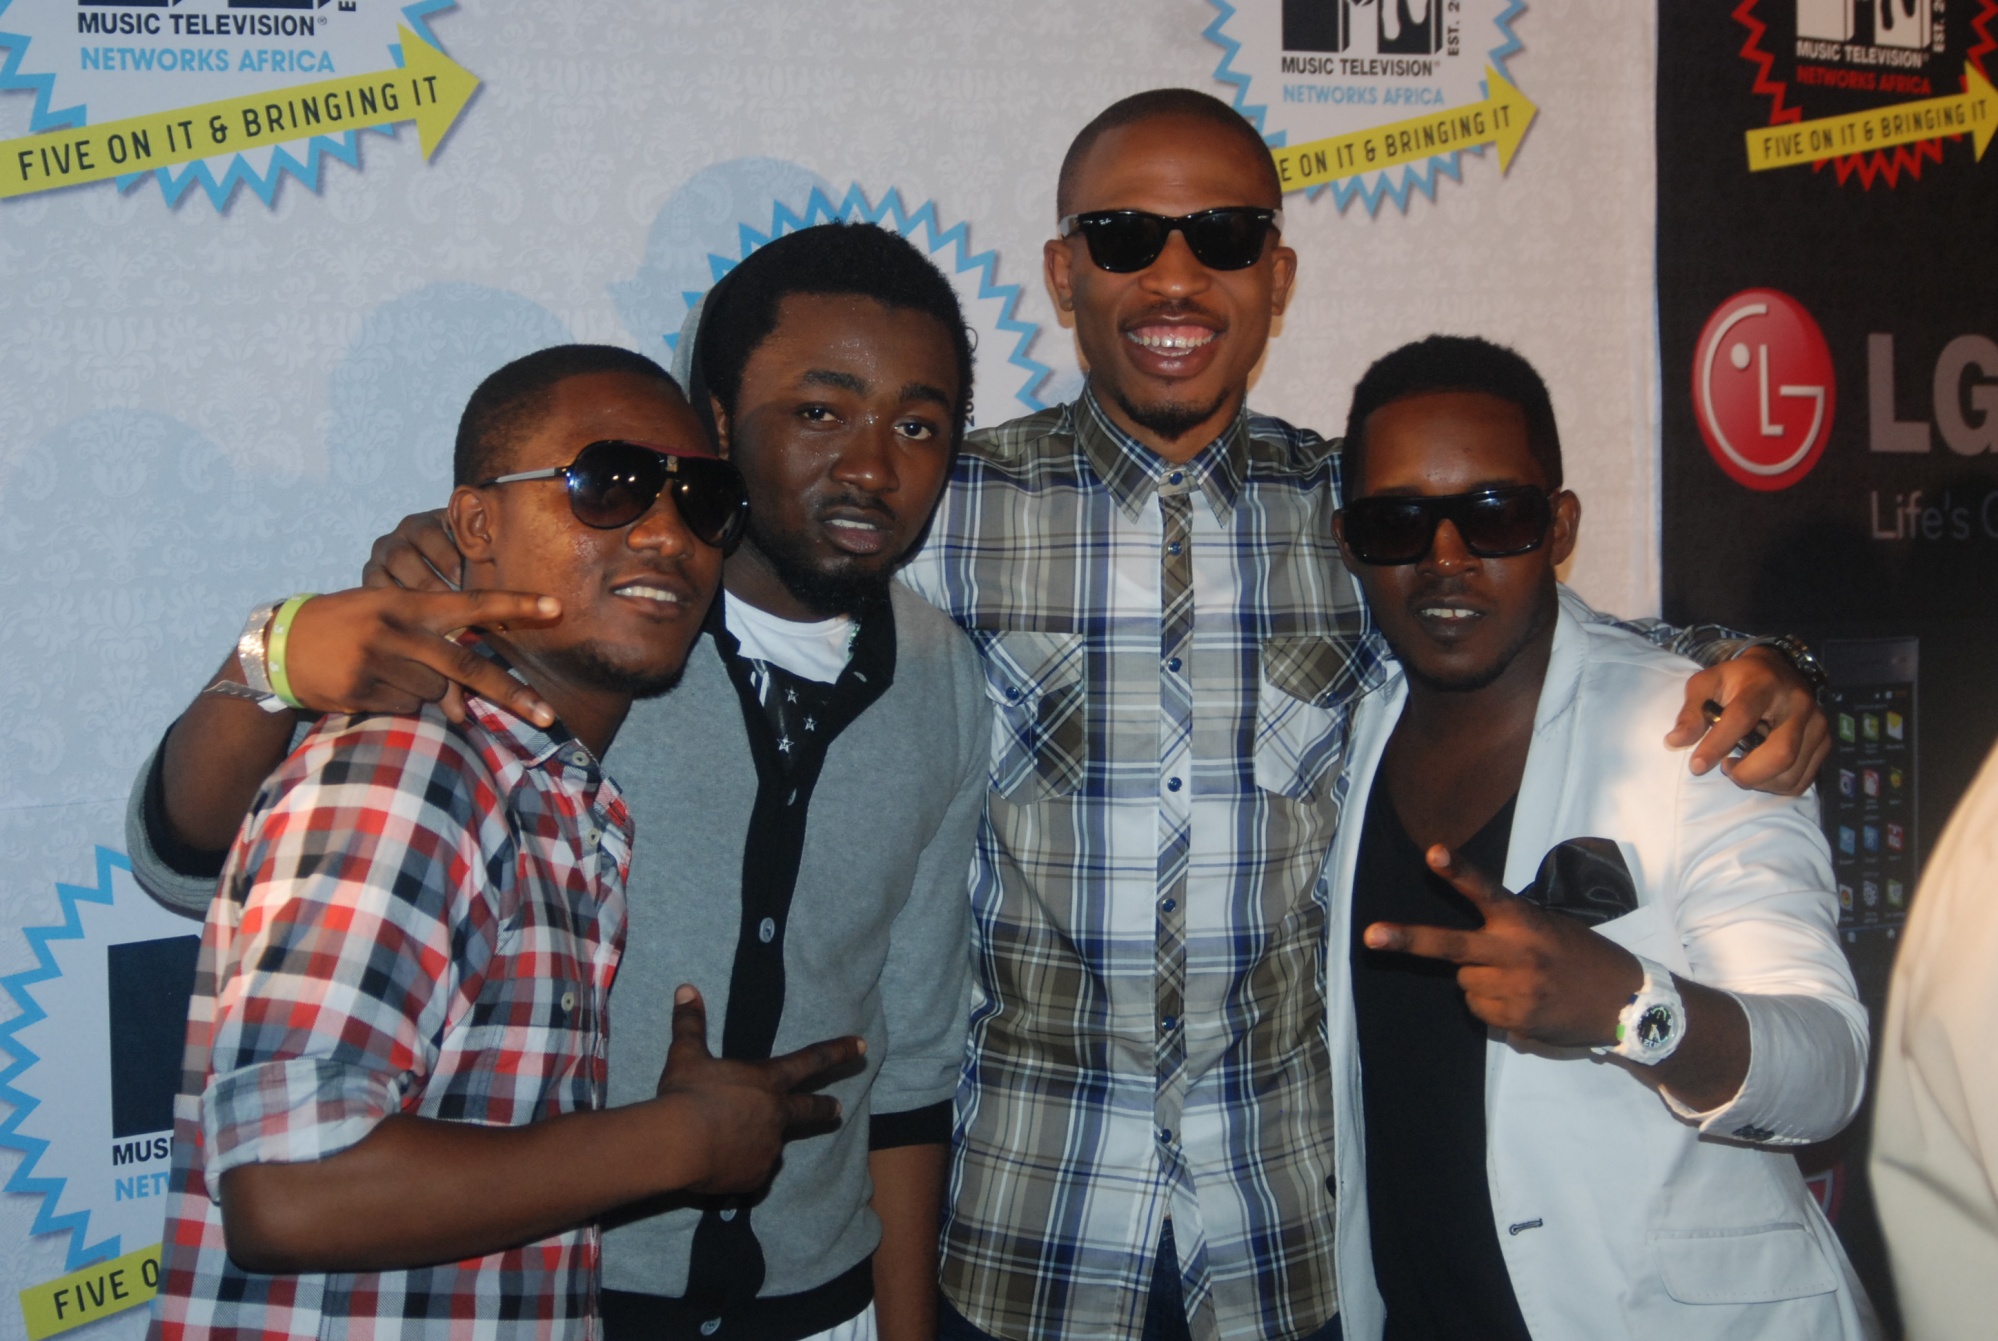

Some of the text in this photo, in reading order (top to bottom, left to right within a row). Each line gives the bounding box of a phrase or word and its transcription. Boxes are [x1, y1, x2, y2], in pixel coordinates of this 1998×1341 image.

[77, 12, 161, 35] MUSIC
[80, 47, 335, 73] NETWORKS AFRICA
[1281, 57, 1334, 75] MUSIC
[1796, 41, 1841, 60] MUSIC
[1283, 84, 1445, 106] NETWORKS AFRICA
[1797, 66, 1932, 94] NETWORKS AFRICA
[18, 75, 437, 181] FIVE ON IT & BRINGING IT
[1299, 150, 1328, 178] ON
[1336, 142, 1355, 169] IT
[1364, 139, 1376, 162] &
[1384, 111, 1486, 158] BRINGING
[1493, 105, 1511, 130] IT
[1763, 99, 1986, 160] FIVE ON IT & BRINGING IT
[1868, 333, 1998, 456] LG
[1872, 490, 1970, 540] Life's
[53, 1269, 129, 1320] FIVE
